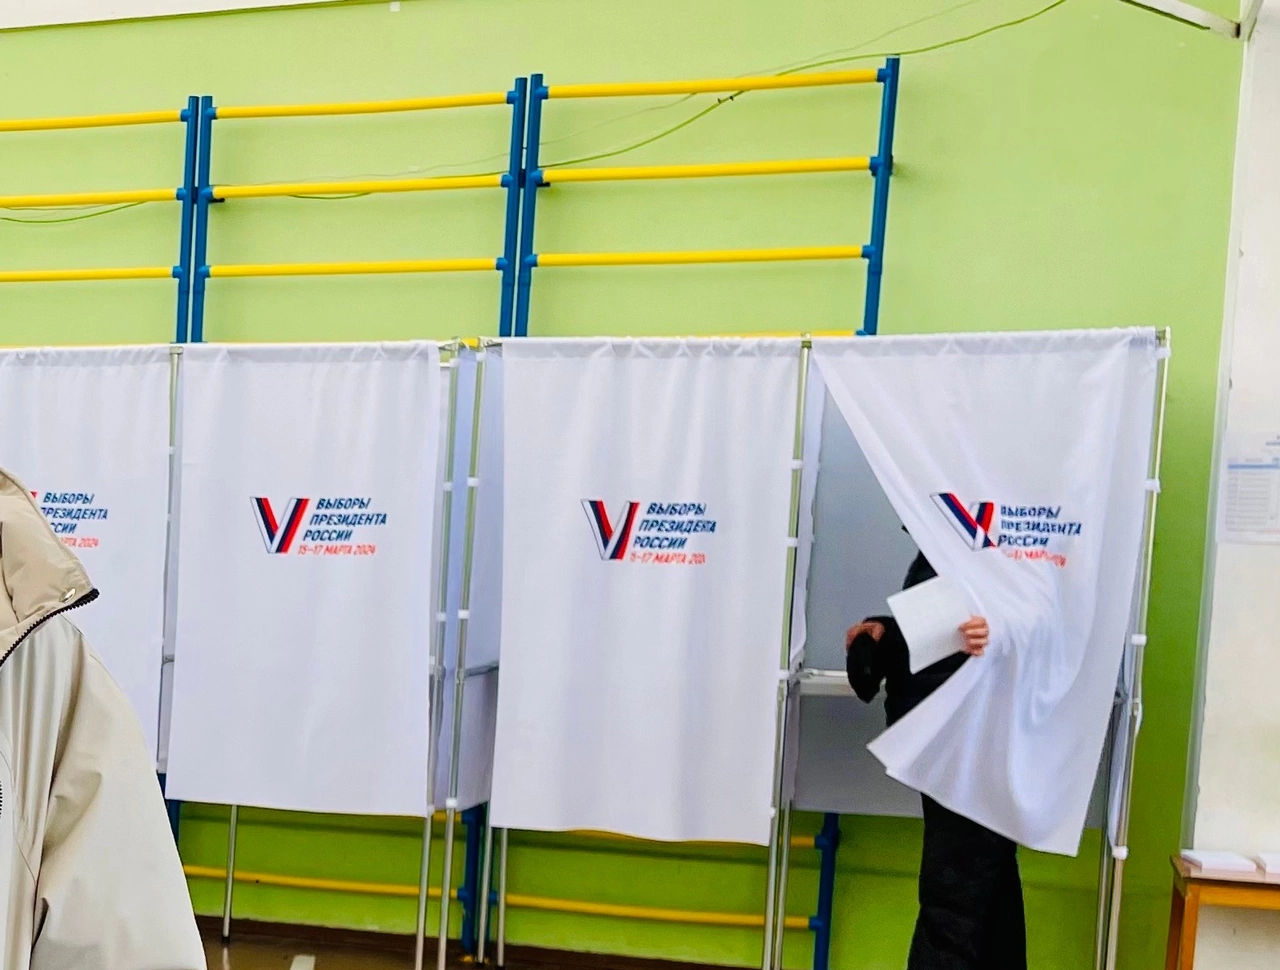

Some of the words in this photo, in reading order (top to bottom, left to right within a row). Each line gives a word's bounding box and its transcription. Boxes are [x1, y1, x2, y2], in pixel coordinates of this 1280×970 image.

[43, 492, 95, 505] ВЫБОРЫ
[316, 498, 371, 510] ВЫБОРЫ
[647, 503, 707, 516] ВЫБОРЫ
[309, 513, 387, 526] ПРЕЗИДЕНТА
[303, 530, 353, 541] РОССИИ
[633, 536, 688, 549] РОССИИ
